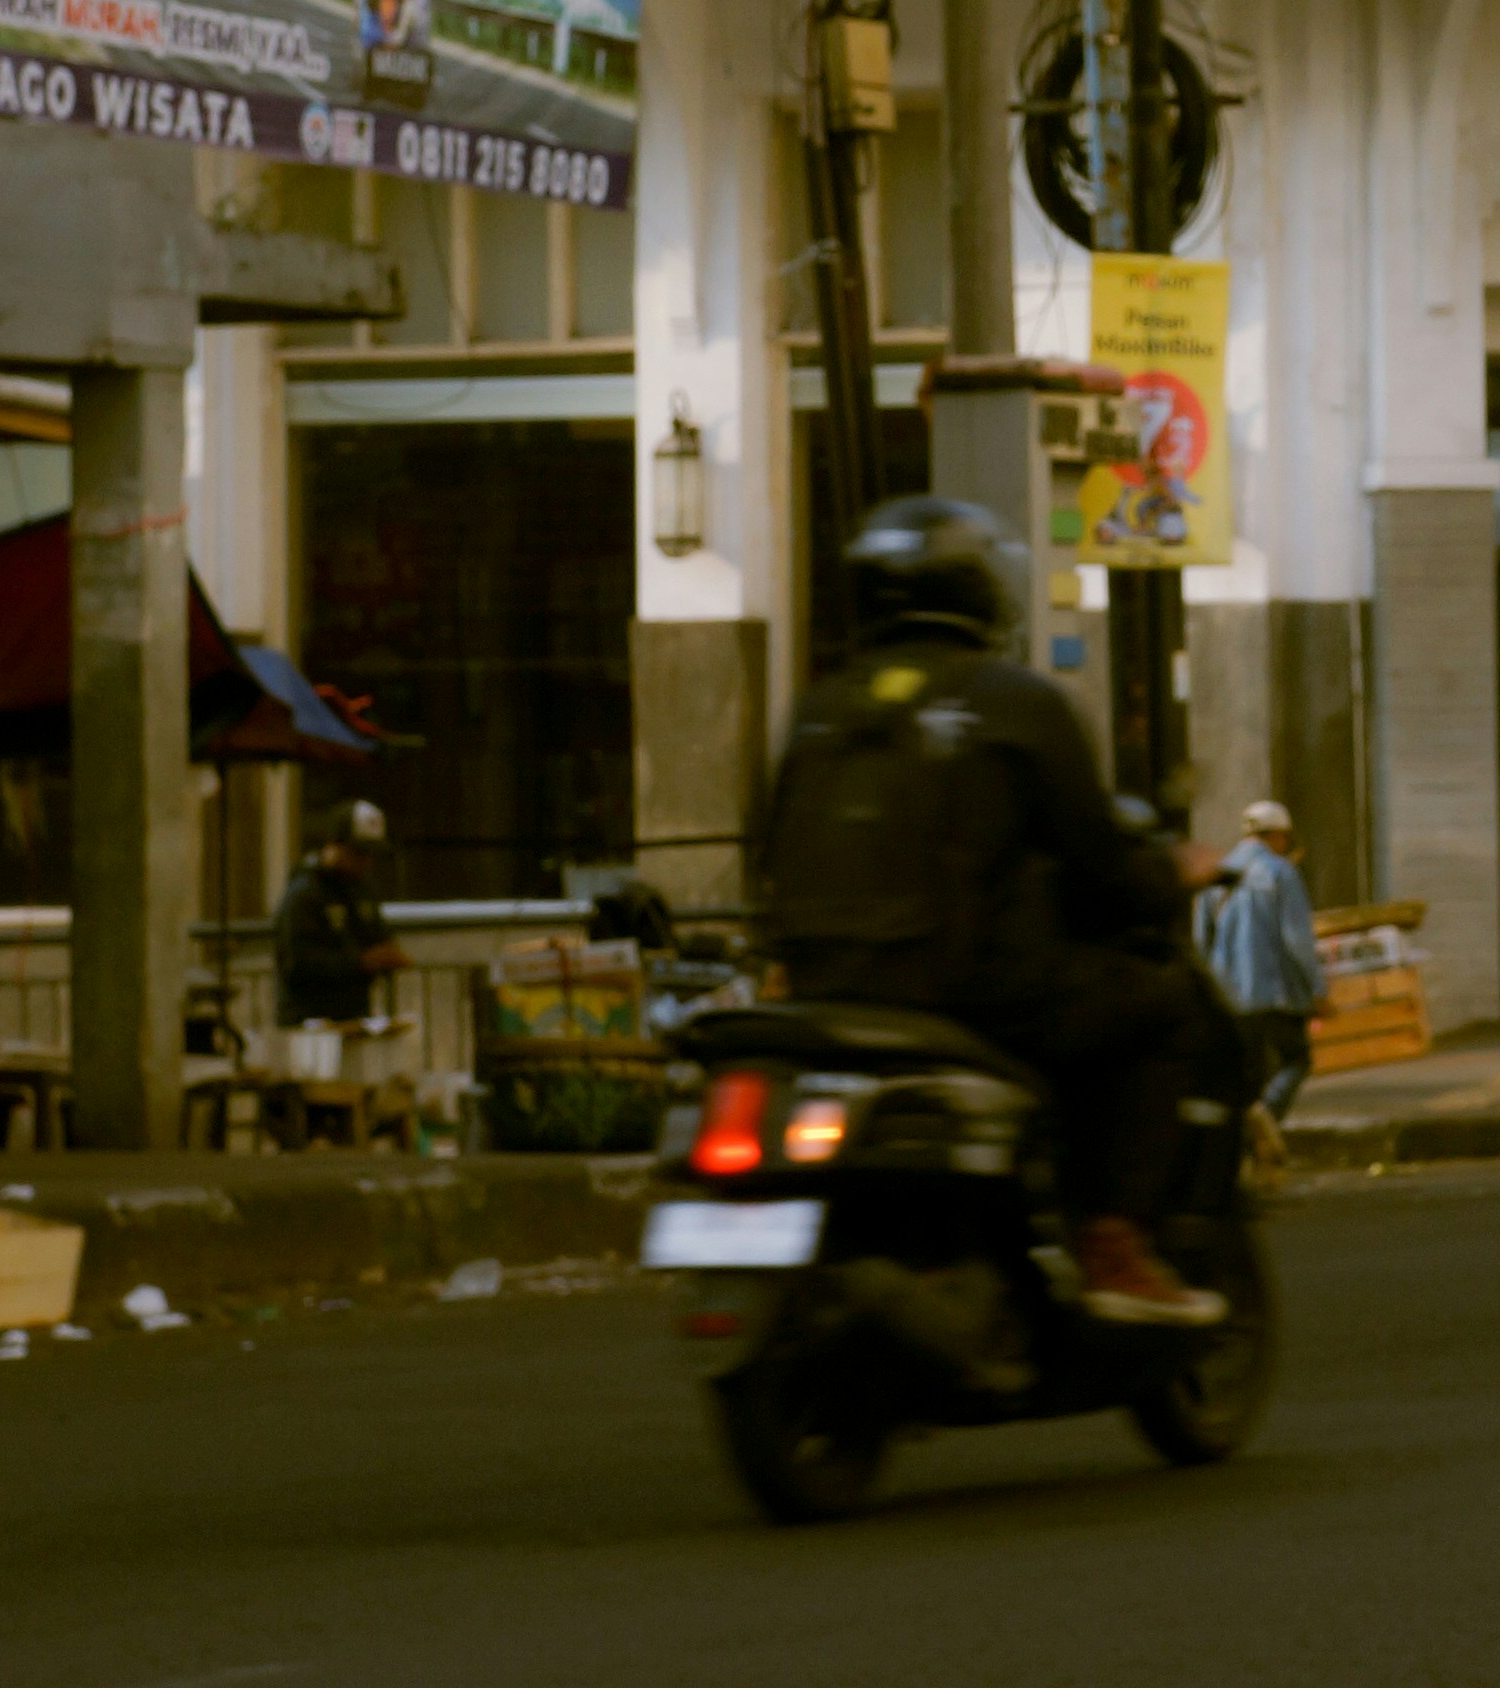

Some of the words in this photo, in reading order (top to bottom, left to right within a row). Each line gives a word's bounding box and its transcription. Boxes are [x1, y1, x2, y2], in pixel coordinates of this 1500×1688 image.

[91, 72, 257, 151] WISATA
[400, 120, 470, 181] 0811
[474, 133, 526, 192] 215
